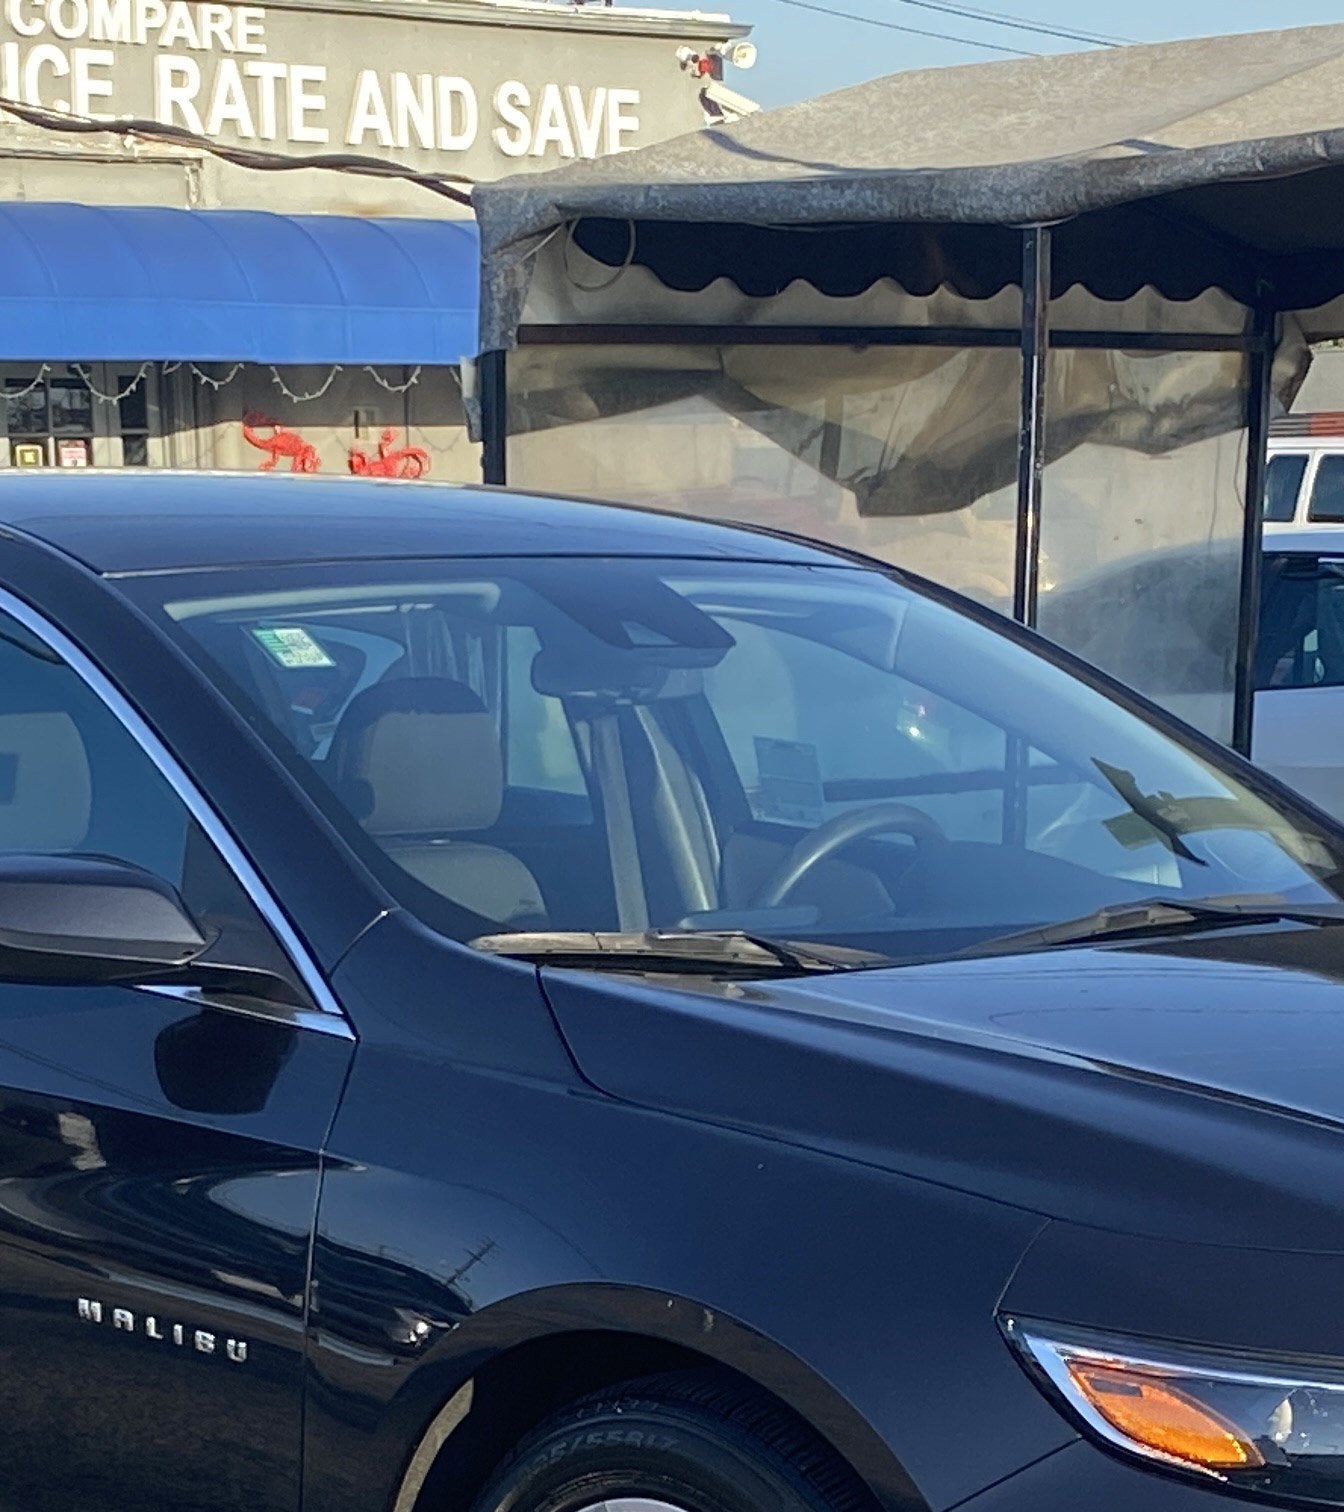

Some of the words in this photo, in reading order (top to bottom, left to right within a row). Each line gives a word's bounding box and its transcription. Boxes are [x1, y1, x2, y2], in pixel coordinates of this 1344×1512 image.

[5, 0, 267, 54] COMPARE
[153, 54, 329, 143] RATE
[345, 69, 479, 151] AND
[492, 80, 640, 158] SAVE
[77, 1297, 248, 1363] MALIBU
